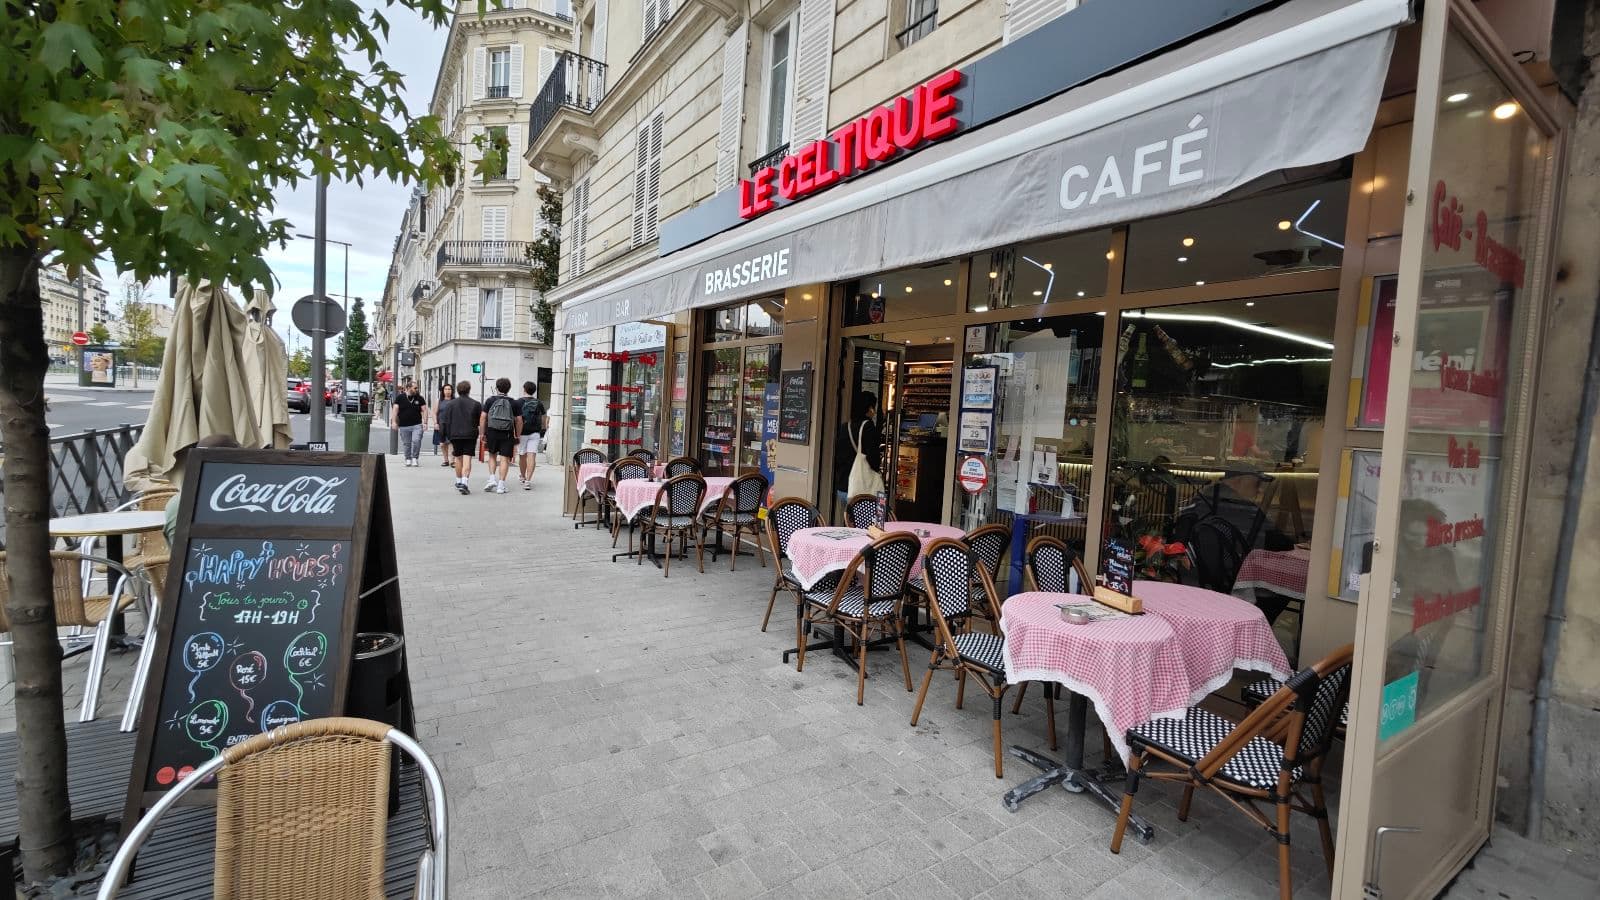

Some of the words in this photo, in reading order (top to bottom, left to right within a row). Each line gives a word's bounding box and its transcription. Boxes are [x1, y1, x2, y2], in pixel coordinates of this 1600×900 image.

[739, 166, 775, 219] LE
[778, 69, 961, 200] CELTIQUE
[1059, 113, 1209, 210] CAFÉ
[705, 248, 790, 295] BRASSERIE
[615, 299, 630, 318] BAR
[309, 443, 326, 452] PIZZA
[210, 473, 347, 514] Coca-Cola
[199, 549, 265, 585] HAPPY
[268, 554, 331, 582] HOURS
[214, 592, 240, 605] Tous
[243, 595, 256, 604] les
[257, 596, 288, 609] jours
[290, 646, 318, 658] Cocktail
[197, 660, 209, 669] 5€
[236, 663, 255, 674] Rosé
[298, 658, 312, 667] 6€
[238, 674, 257, 684] 15€
[199, 725, 213, 735] 3€
